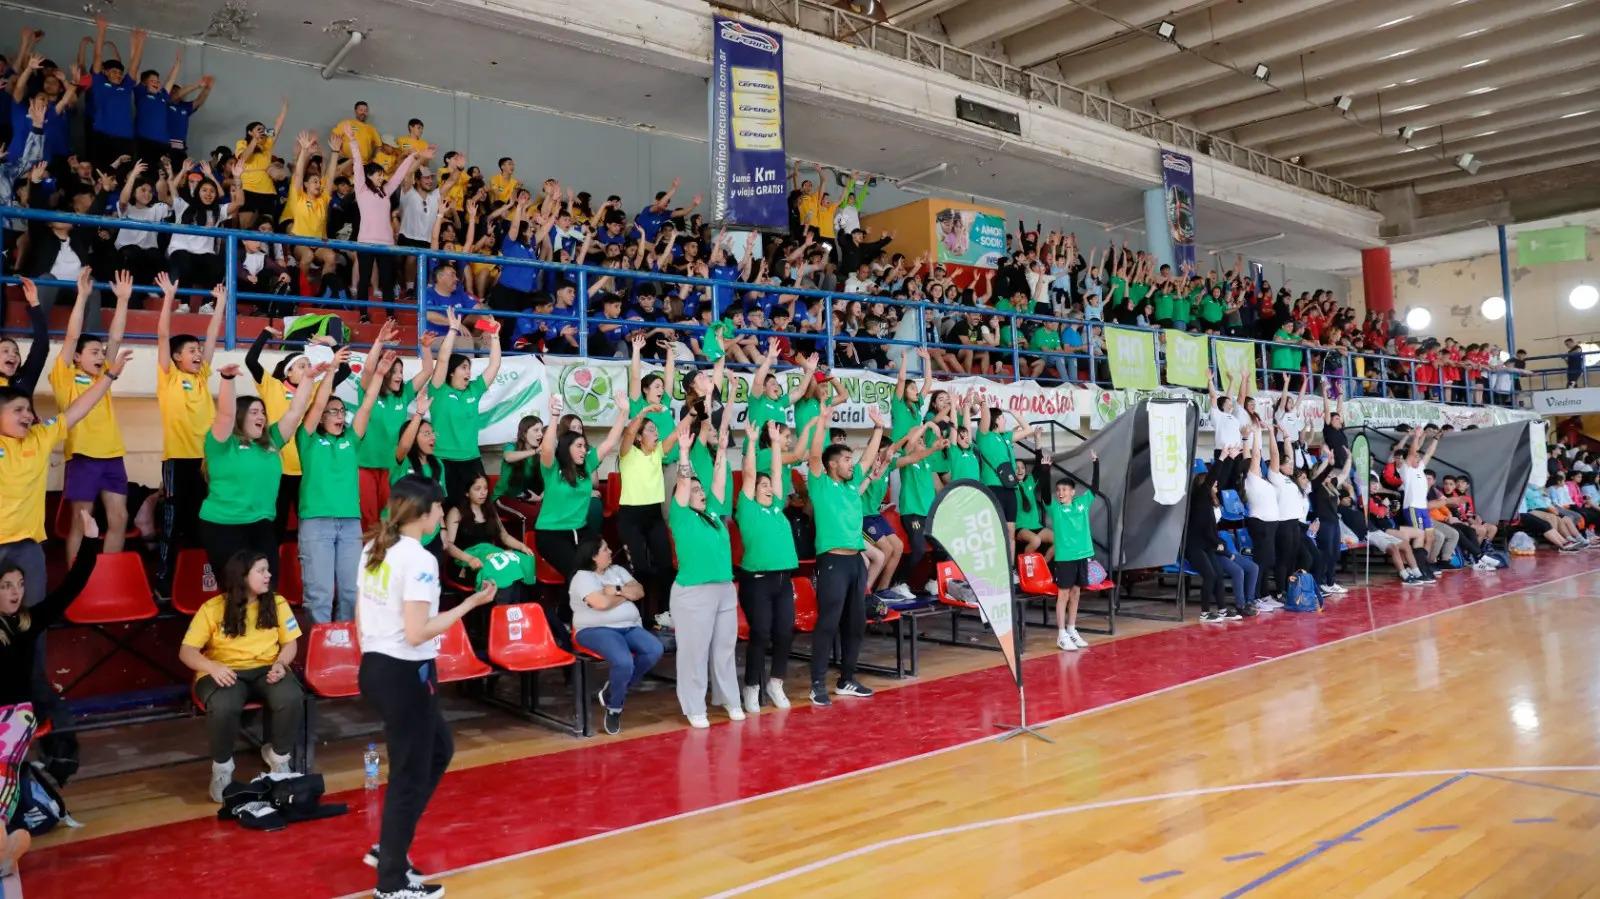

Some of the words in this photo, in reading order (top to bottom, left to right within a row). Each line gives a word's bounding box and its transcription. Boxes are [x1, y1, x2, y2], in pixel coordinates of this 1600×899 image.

[755, 167, 776, 182] Km
[756, 184, 784, 195] GRATIS!
[1546, 396, 1582, 407] Viedma
[832, 407, 866, 423] ocial
